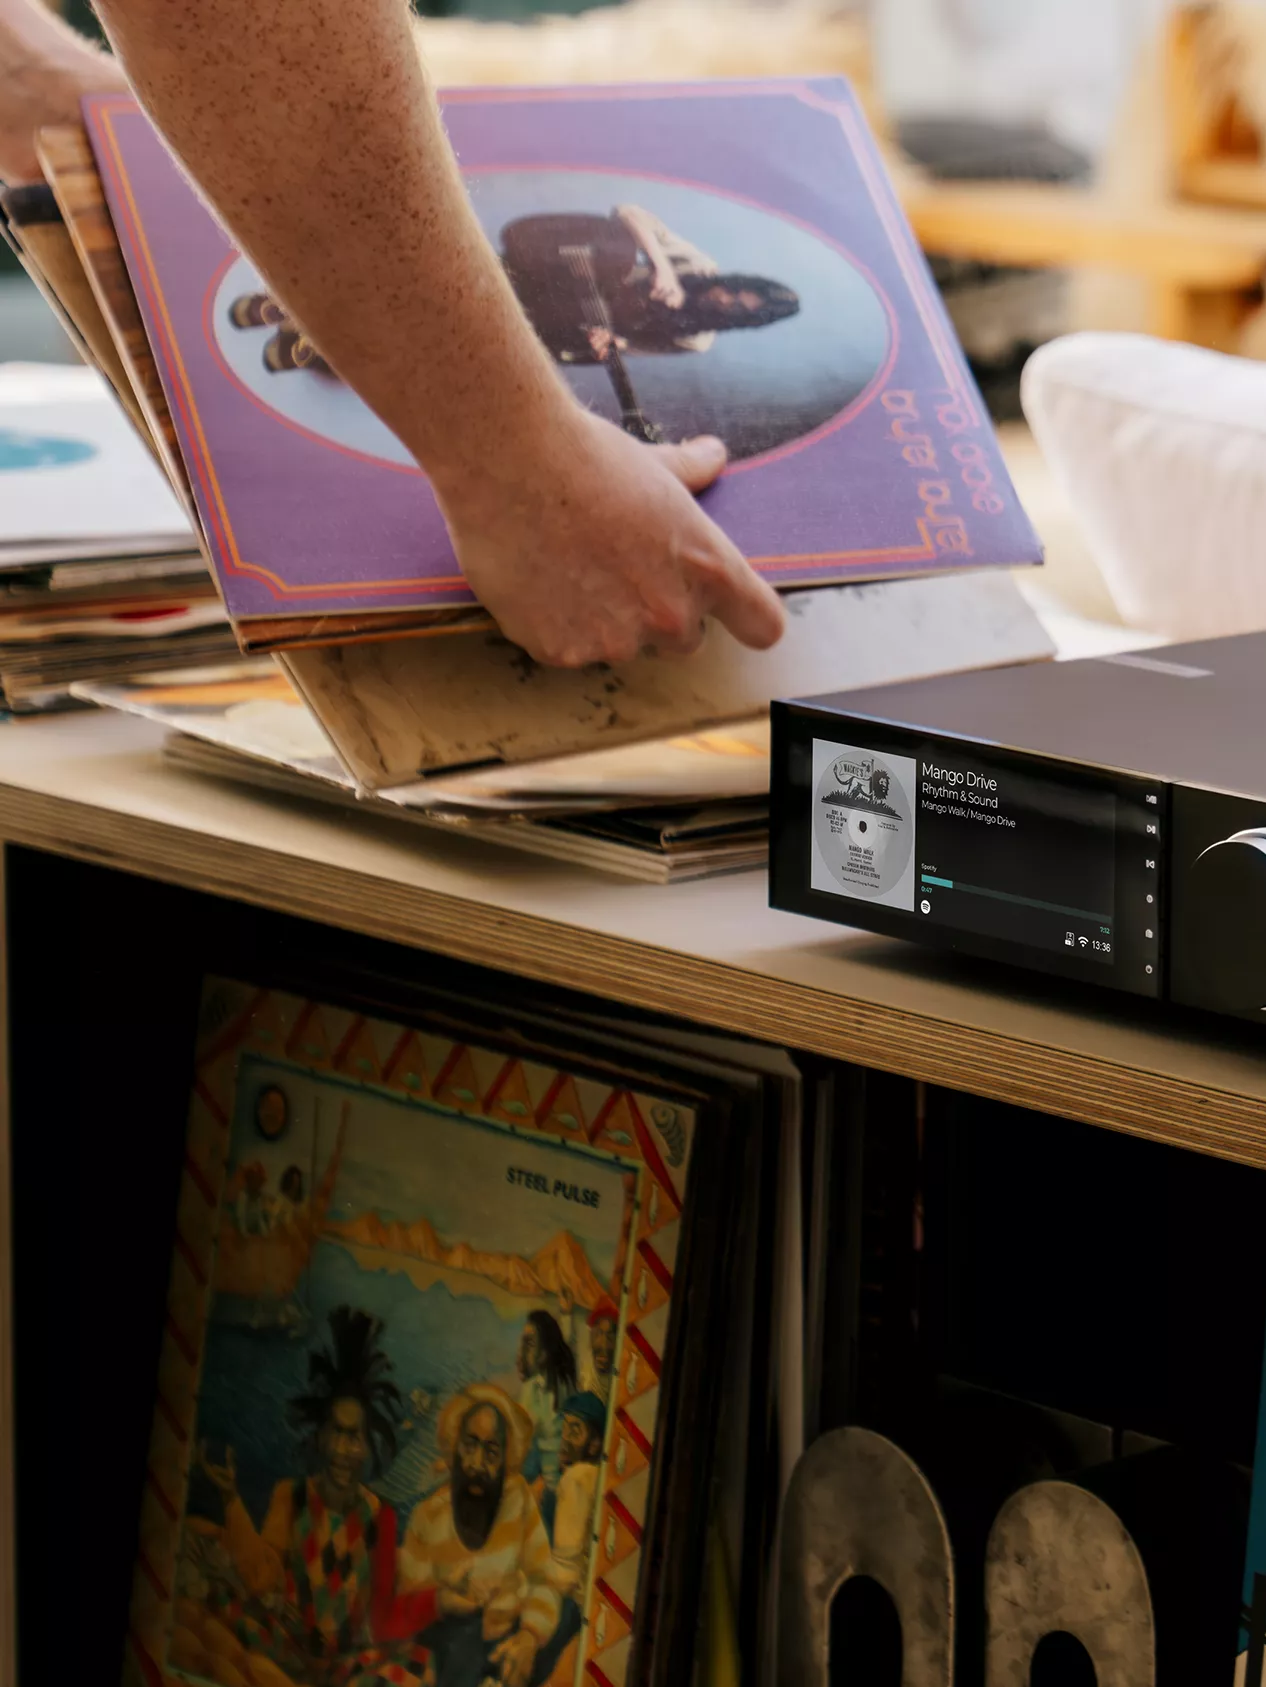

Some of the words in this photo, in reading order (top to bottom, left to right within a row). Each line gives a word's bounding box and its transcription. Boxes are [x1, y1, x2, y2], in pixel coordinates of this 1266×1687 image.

[922, 762, 964, 786] Mango
[966, 771, 997, 791] Drive
[922, 782, 959, 800] Rhythm
[960, 790, 967, 802] &
[967, 792, 998, 809] Sound
[921, 799, 947, 815] Mango
[948, 805, 966, 818] Walk
[970, 810, 997, 825] Mango
[997, 815, 1016, 828] Drive
[921, 863, 938, 873] Spotify
[921, 886, 933, 894] 0:47
[1092, 940, 1111, 953] 13:36
[506, 1166, 550, 1195] STEEL
[552, 1179, 601, 1209] PULSE
